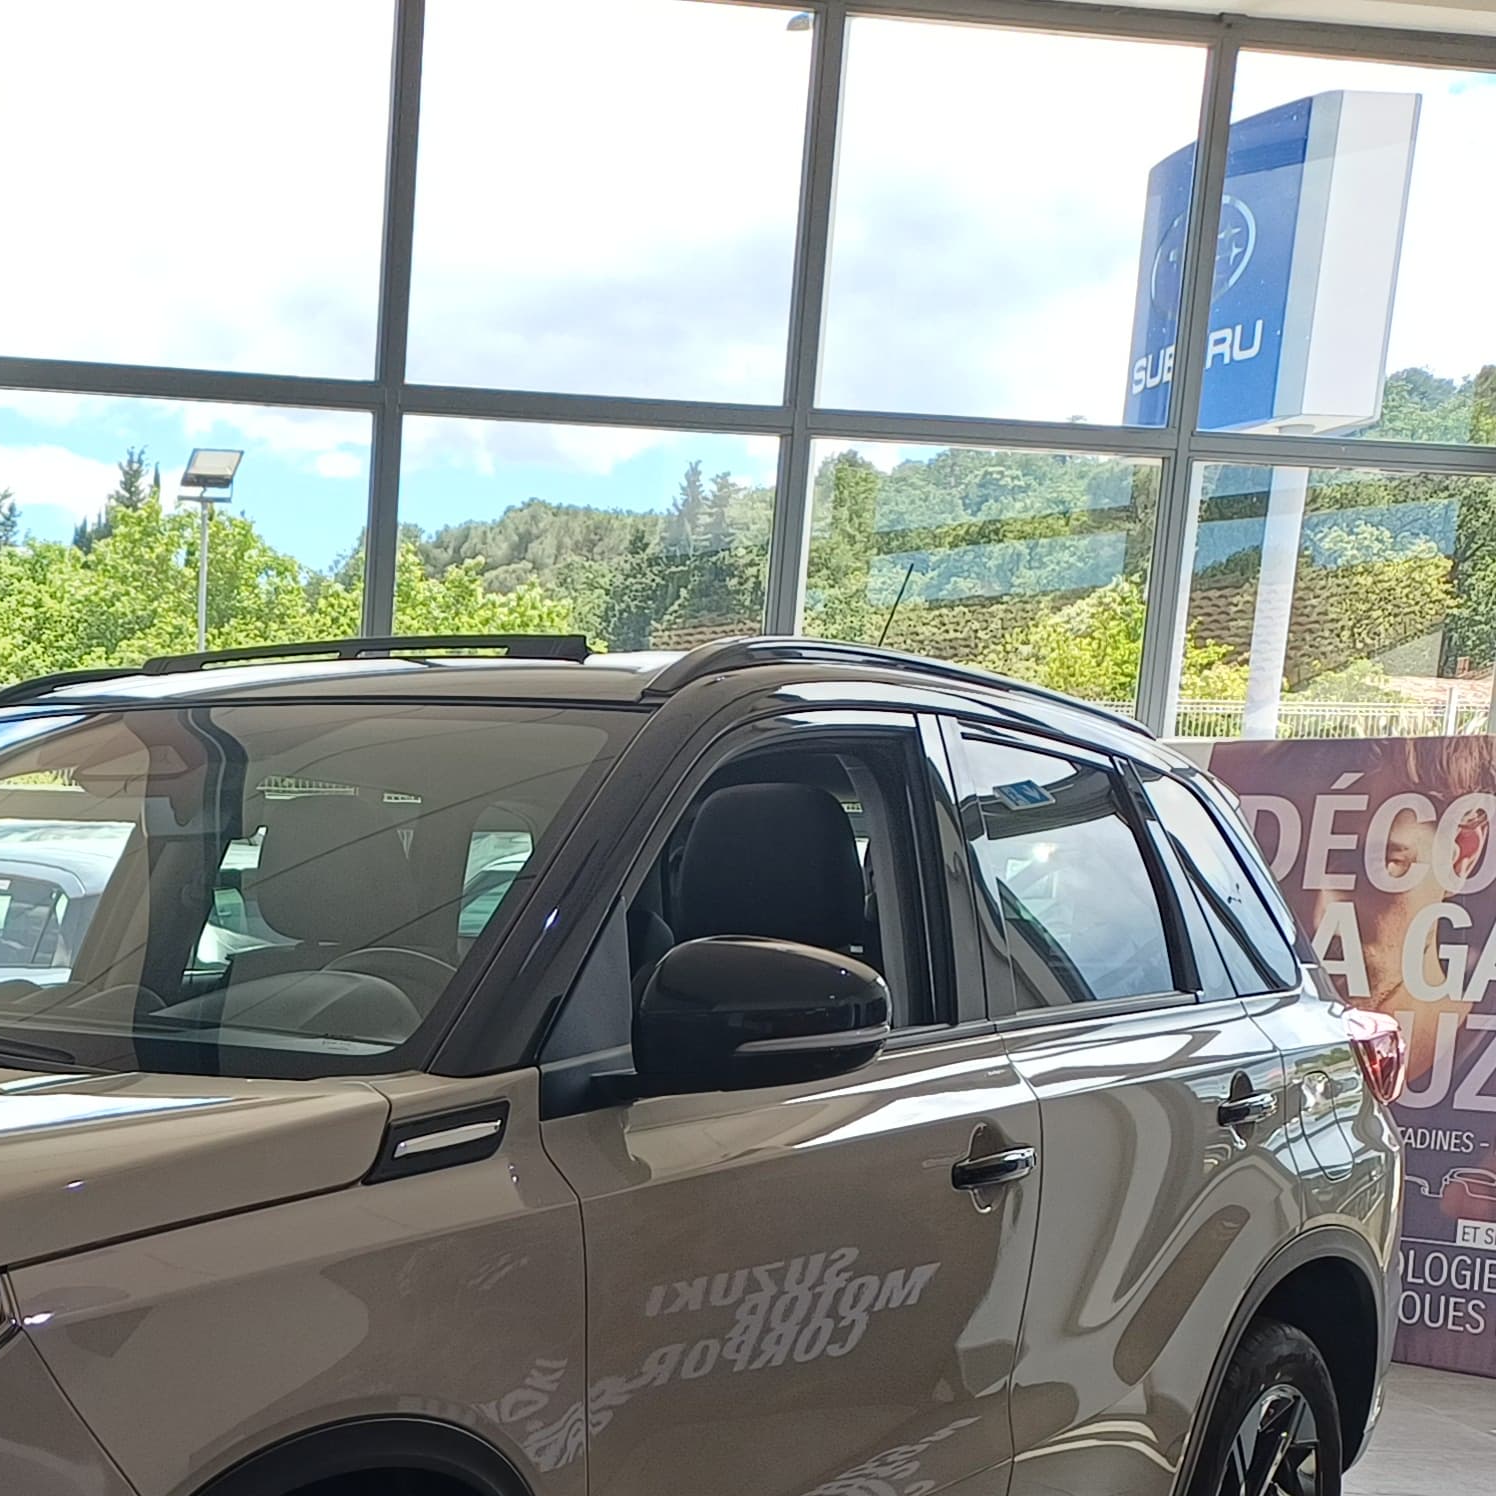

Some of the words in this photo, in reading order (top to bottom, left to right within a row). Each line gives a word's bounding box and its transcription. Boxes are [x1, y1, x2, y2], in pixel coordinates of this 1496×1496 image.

[1132, 319, 1264, 395] SUBRU
[1461, 1226, 1480, 1243] ET
[1484, 1227, 1496, 1246] S
[1399, 1249, 1496, 1293] LOGIE
